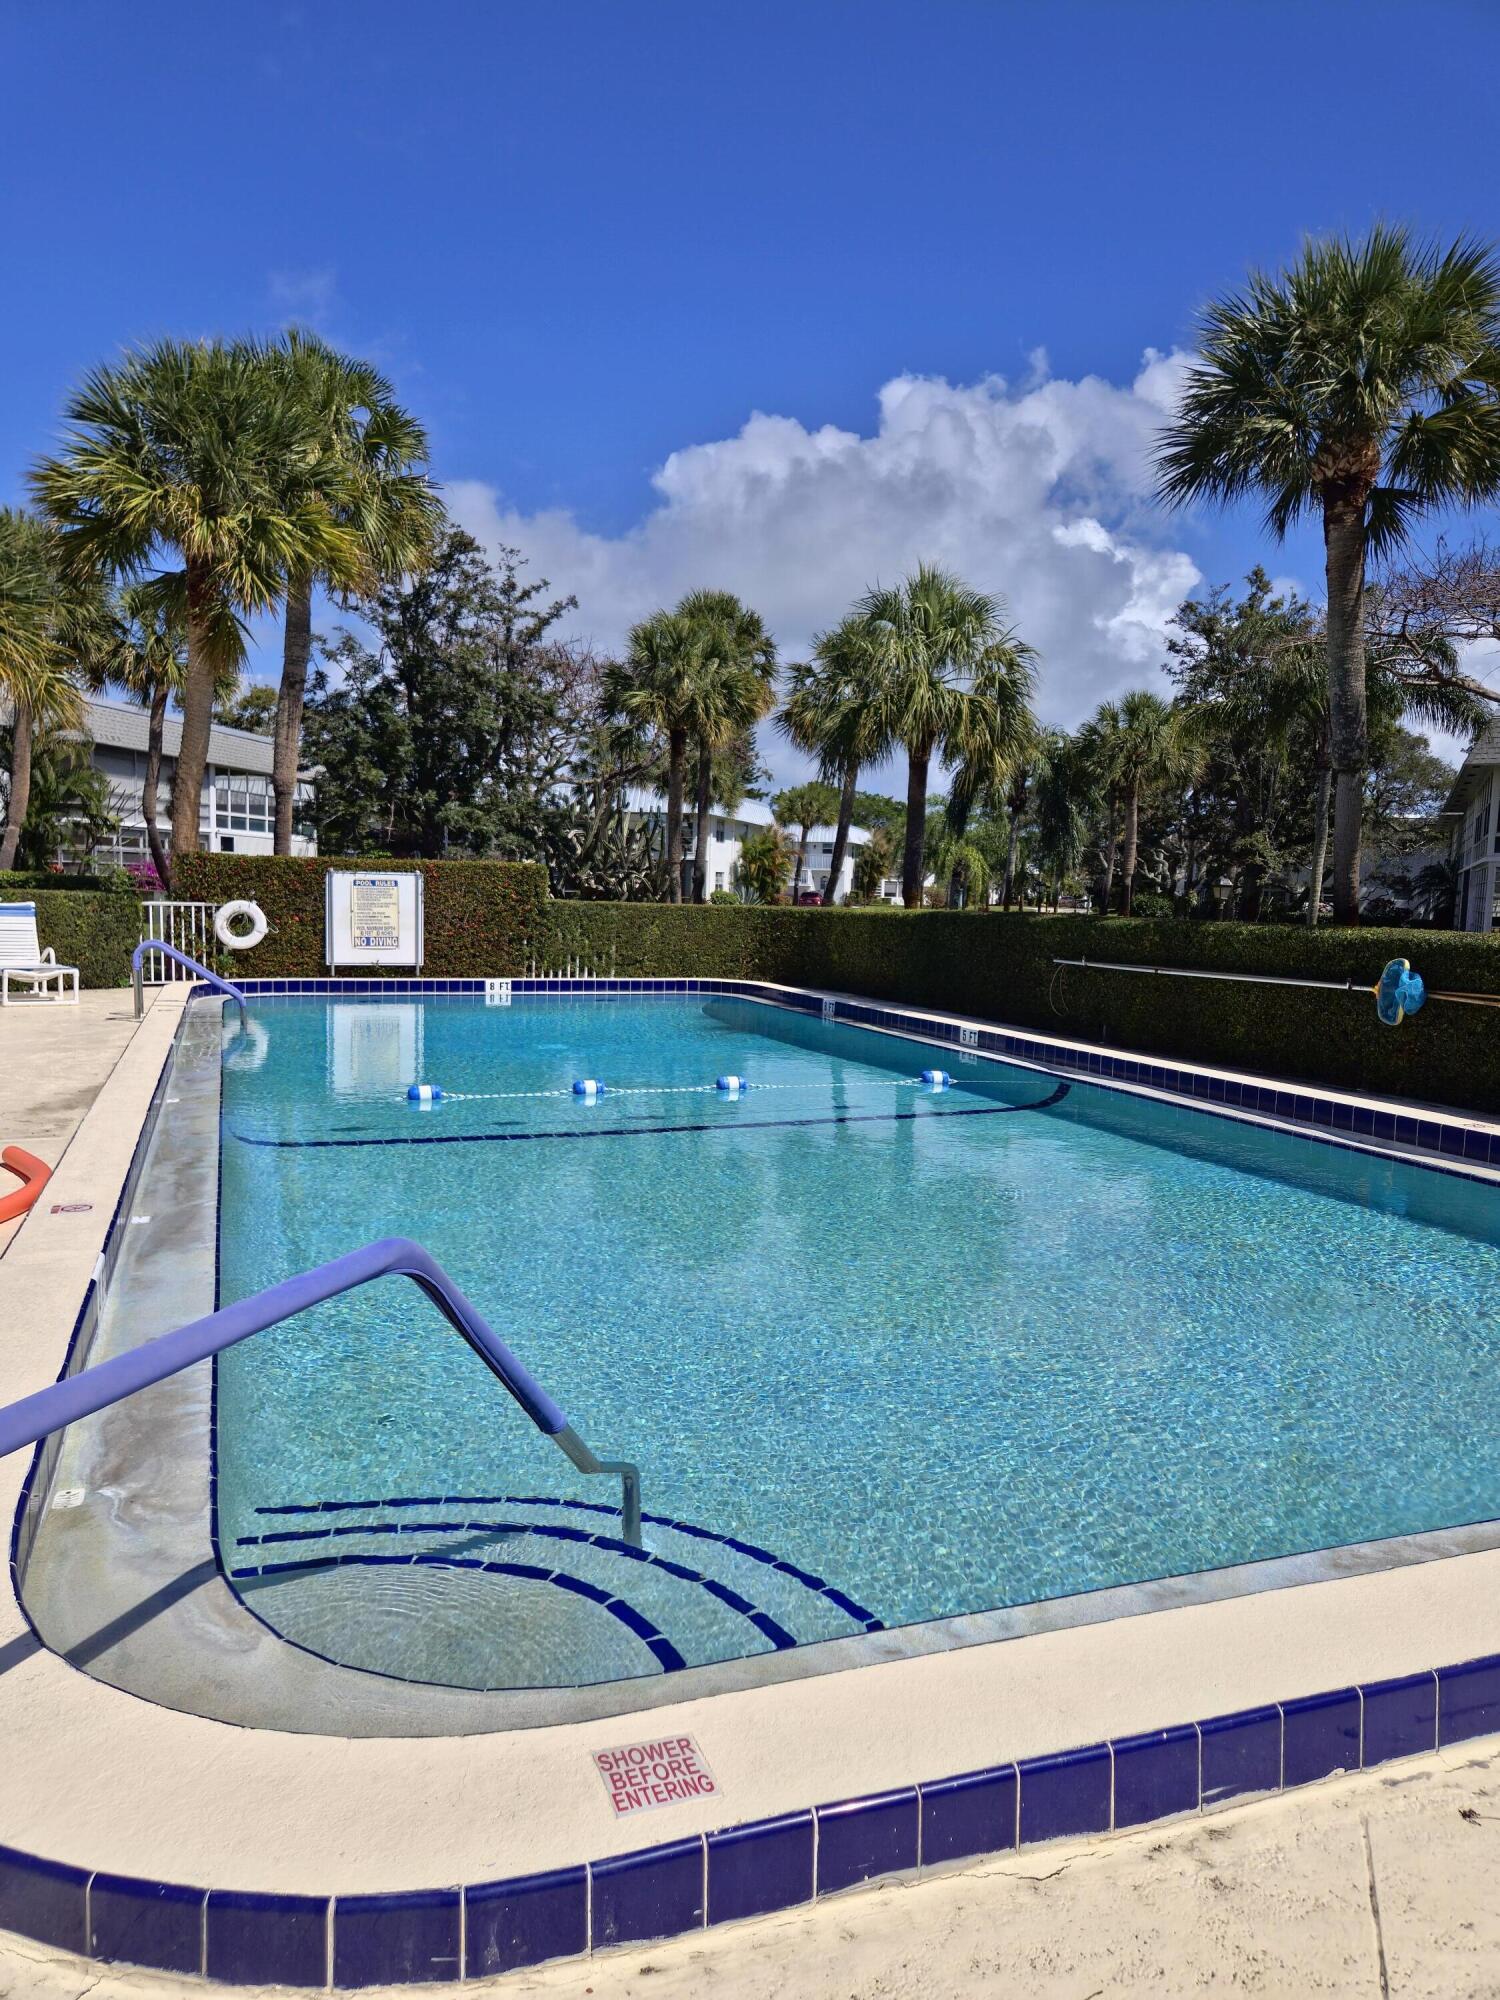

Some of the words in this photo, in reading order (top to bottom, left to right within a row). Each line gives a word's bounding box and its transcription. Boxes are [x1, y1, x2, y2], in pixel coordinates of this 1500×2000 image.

[355, 937, 367, 946] NO
[370, 937, 398, 946] DIVING
[489, 982, 495, 990] 8
[962, 1030, 967, 1041] 5
[969, 1031, 977, 1044] FT
[597, 1738, 696, 1771] SHOWER
[608, 1756, 701, 1790] BEFORE
[611, 1774, 715, 1812] ENTERING
